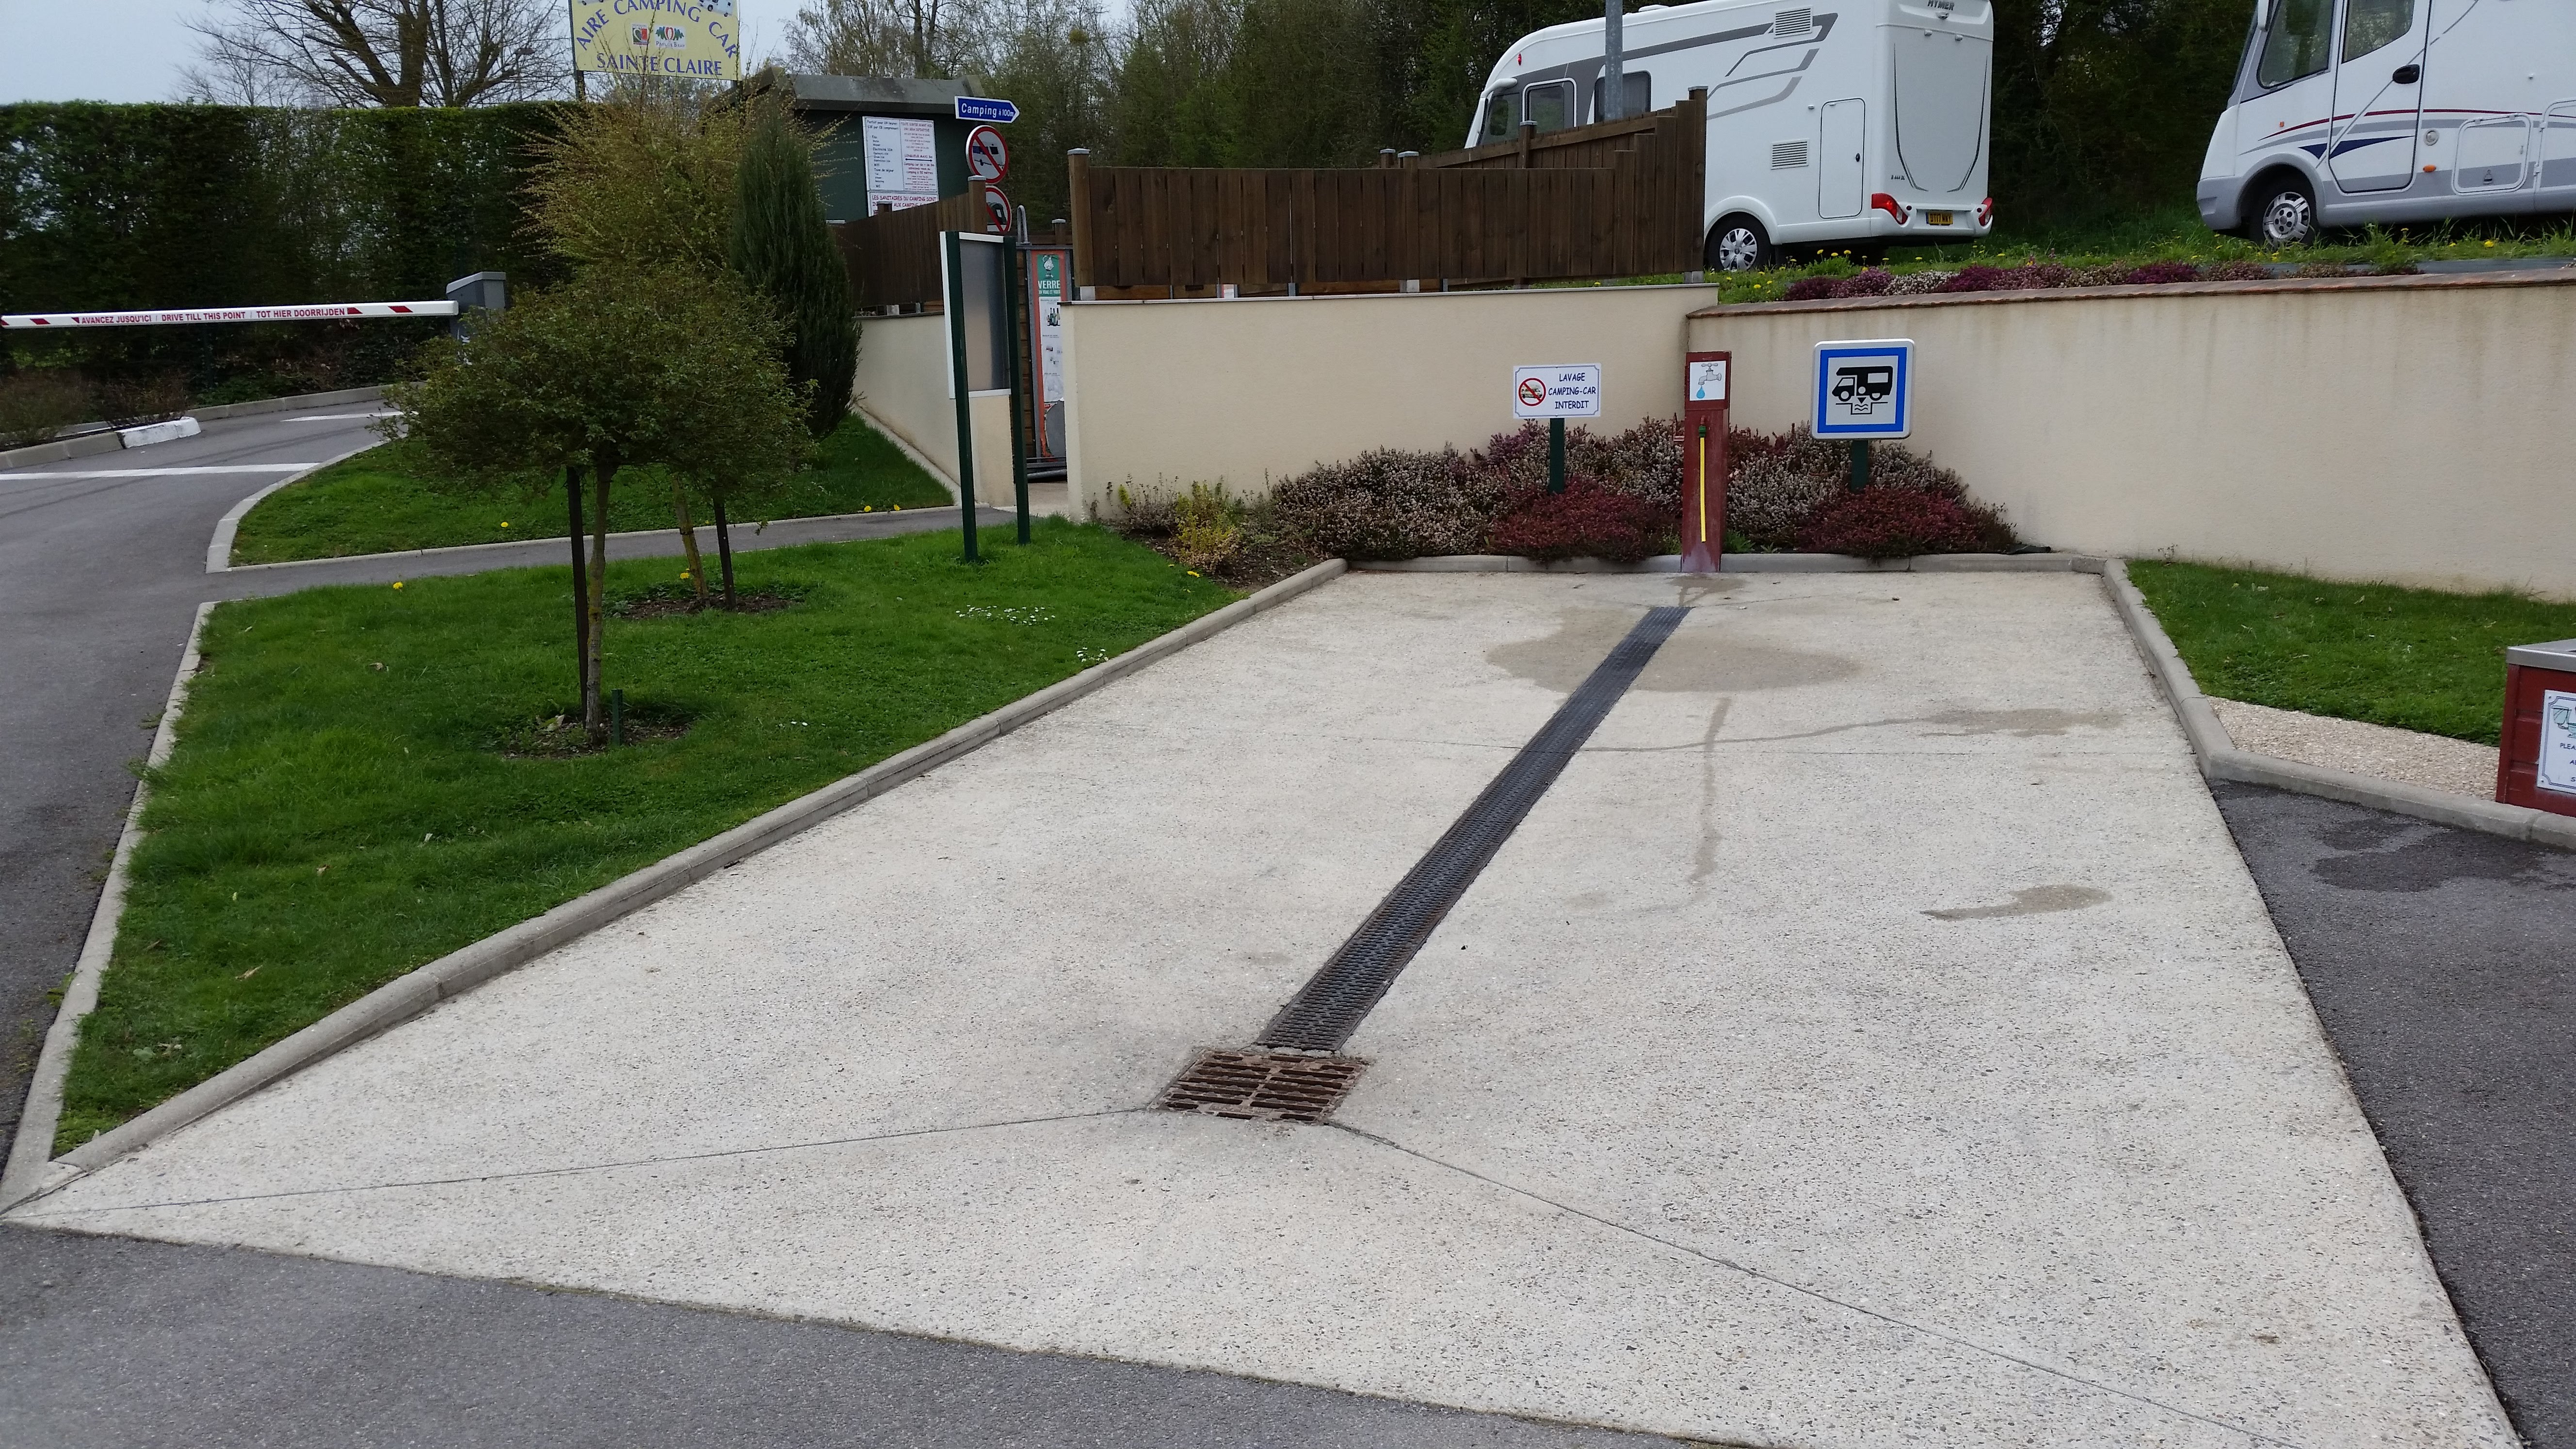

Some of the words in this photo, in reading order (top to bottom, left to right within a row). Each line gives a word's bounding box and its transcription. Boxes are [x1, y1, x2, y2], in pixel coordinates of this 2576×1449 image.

[1928, 0, 1954, 11] HYMER
[577, 9, 609, 50] AIRE
[614, 0, 701, 22] CAMPING
[709, 22, 737, 58] CAR
[597, 52, 658, 71] SAINTE
[664, 57, 722, 75] CLAIRE
[962, 103, 997, 118] Camping
[1038, 280, 1061, 289] VERRE
[294, 308, 345, 317] DOORRIJDEN
[1559, 372, 1585, 382] LAVAGE
[1548, 386, 1596, 395] CAMPING-CAR
[1555, 400, 1589, 409] INTERDIT
